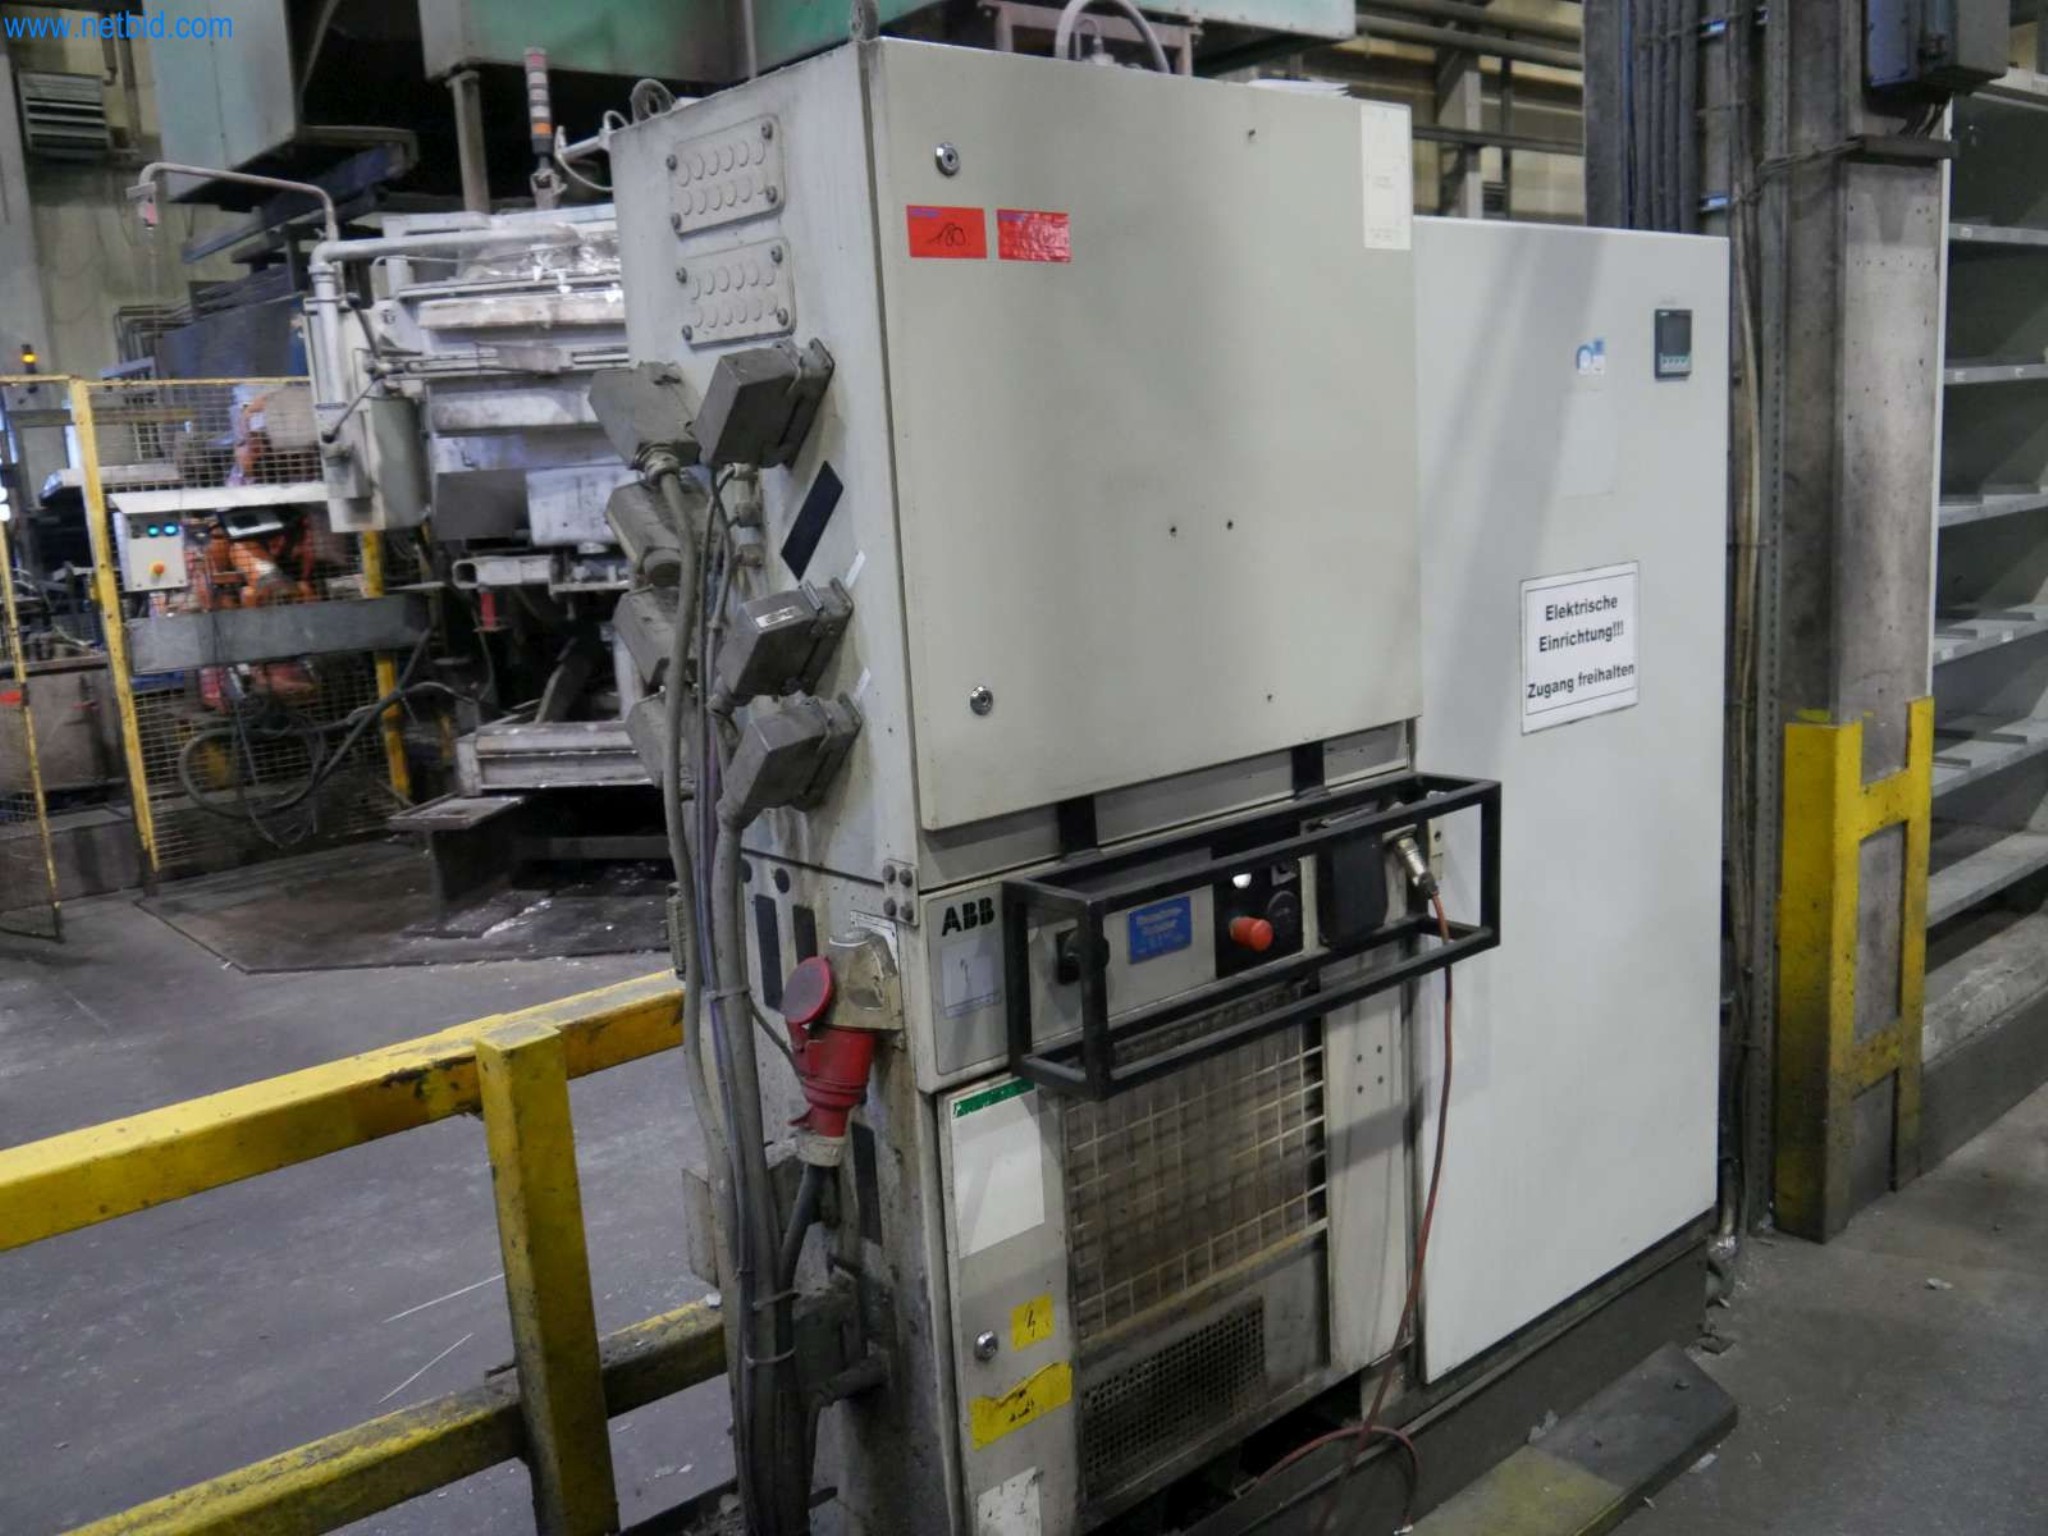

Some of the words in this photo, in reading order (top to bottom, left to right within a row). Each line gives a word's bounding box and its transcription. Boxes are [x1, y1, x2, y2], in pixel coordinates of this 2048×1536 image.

[1545, 595, 1618, 622] Elektrische
[1539, 620, 1624, 653] Einrichtung!!!
[1527, 677, 1575, 699] Zugang
[1578, 663, 1635, 687] freihalten
[941, 897, 995, 937] ABB
